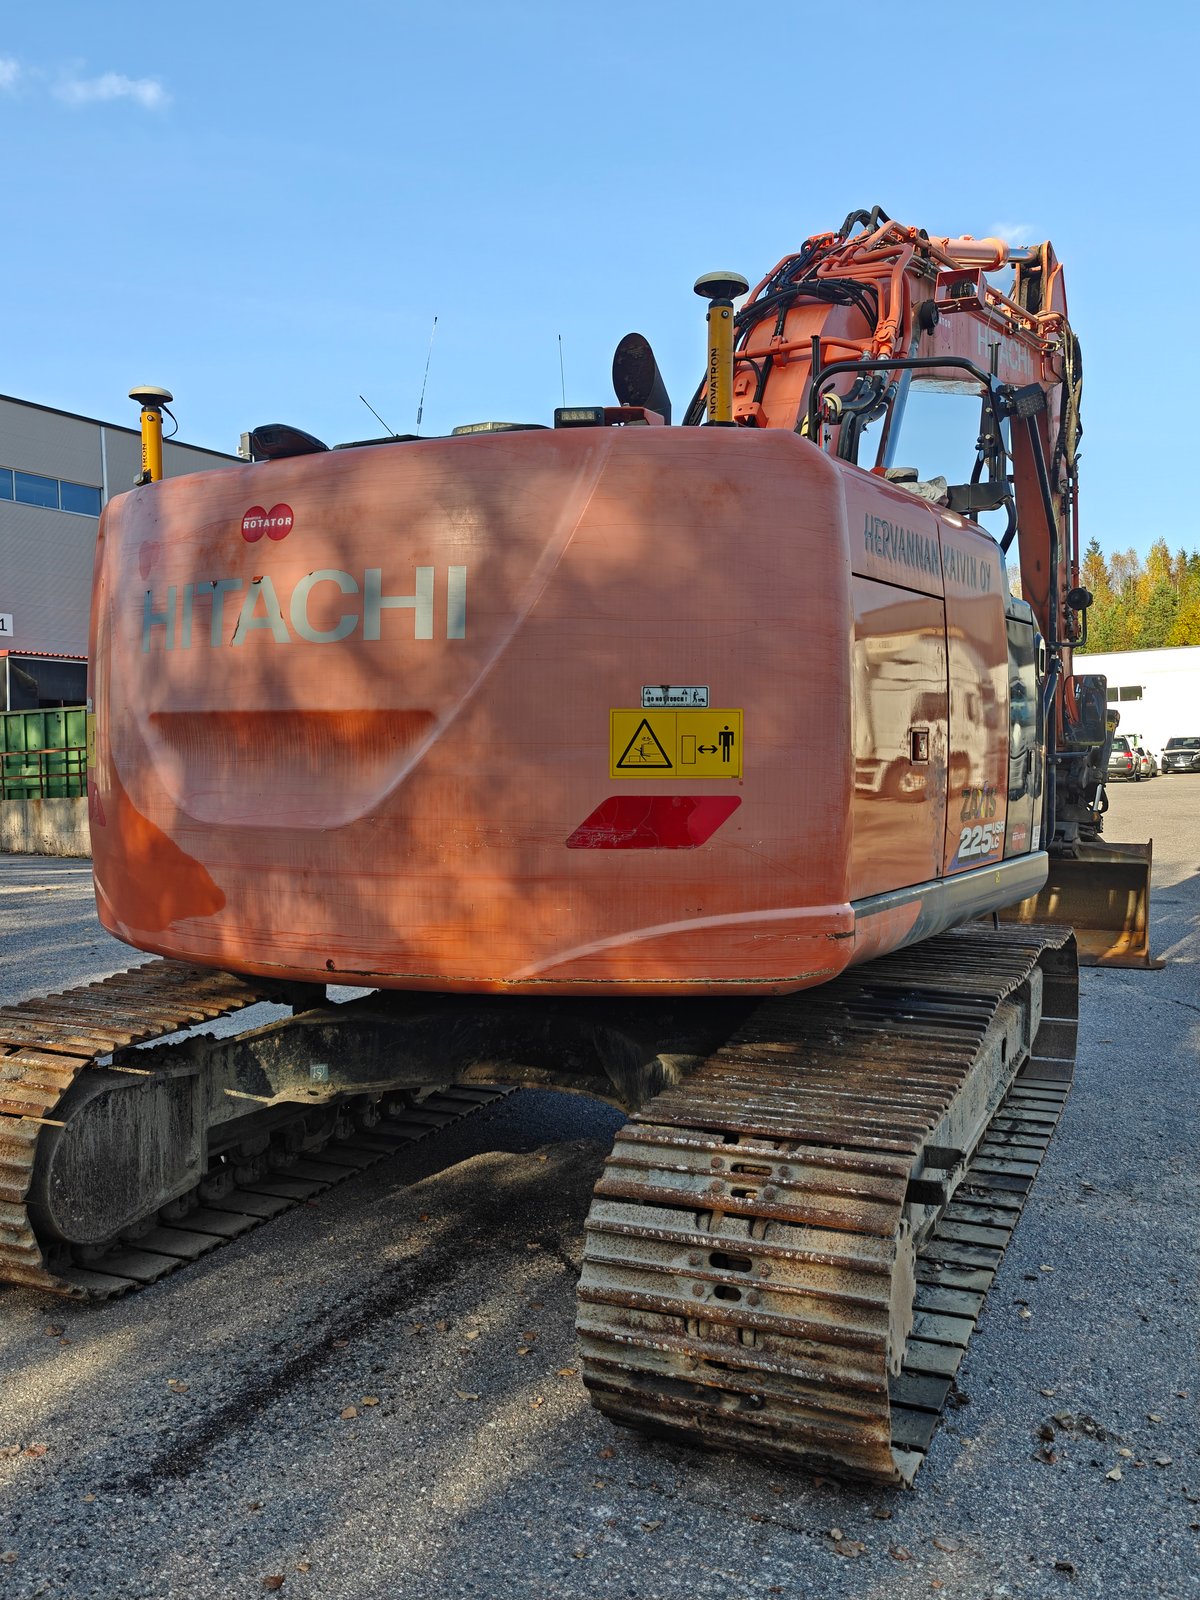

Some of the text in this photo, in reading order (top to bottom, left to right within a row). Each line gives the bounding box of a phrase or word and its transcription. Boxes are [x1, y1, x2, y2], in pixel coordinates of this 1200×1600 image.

[710, 348, 719, 414] NOVATRON
[243, 517, 292, 529] ROTATOR
[864, 513, 991, 592] HERVANNAN KAIVIN OY
[142, 565, 467, 654] HITACHI
[960, 781, 996, 822] ZAXIS
[958, 823, 992, 858] 225
[990, 835, 1000, 850] LC
